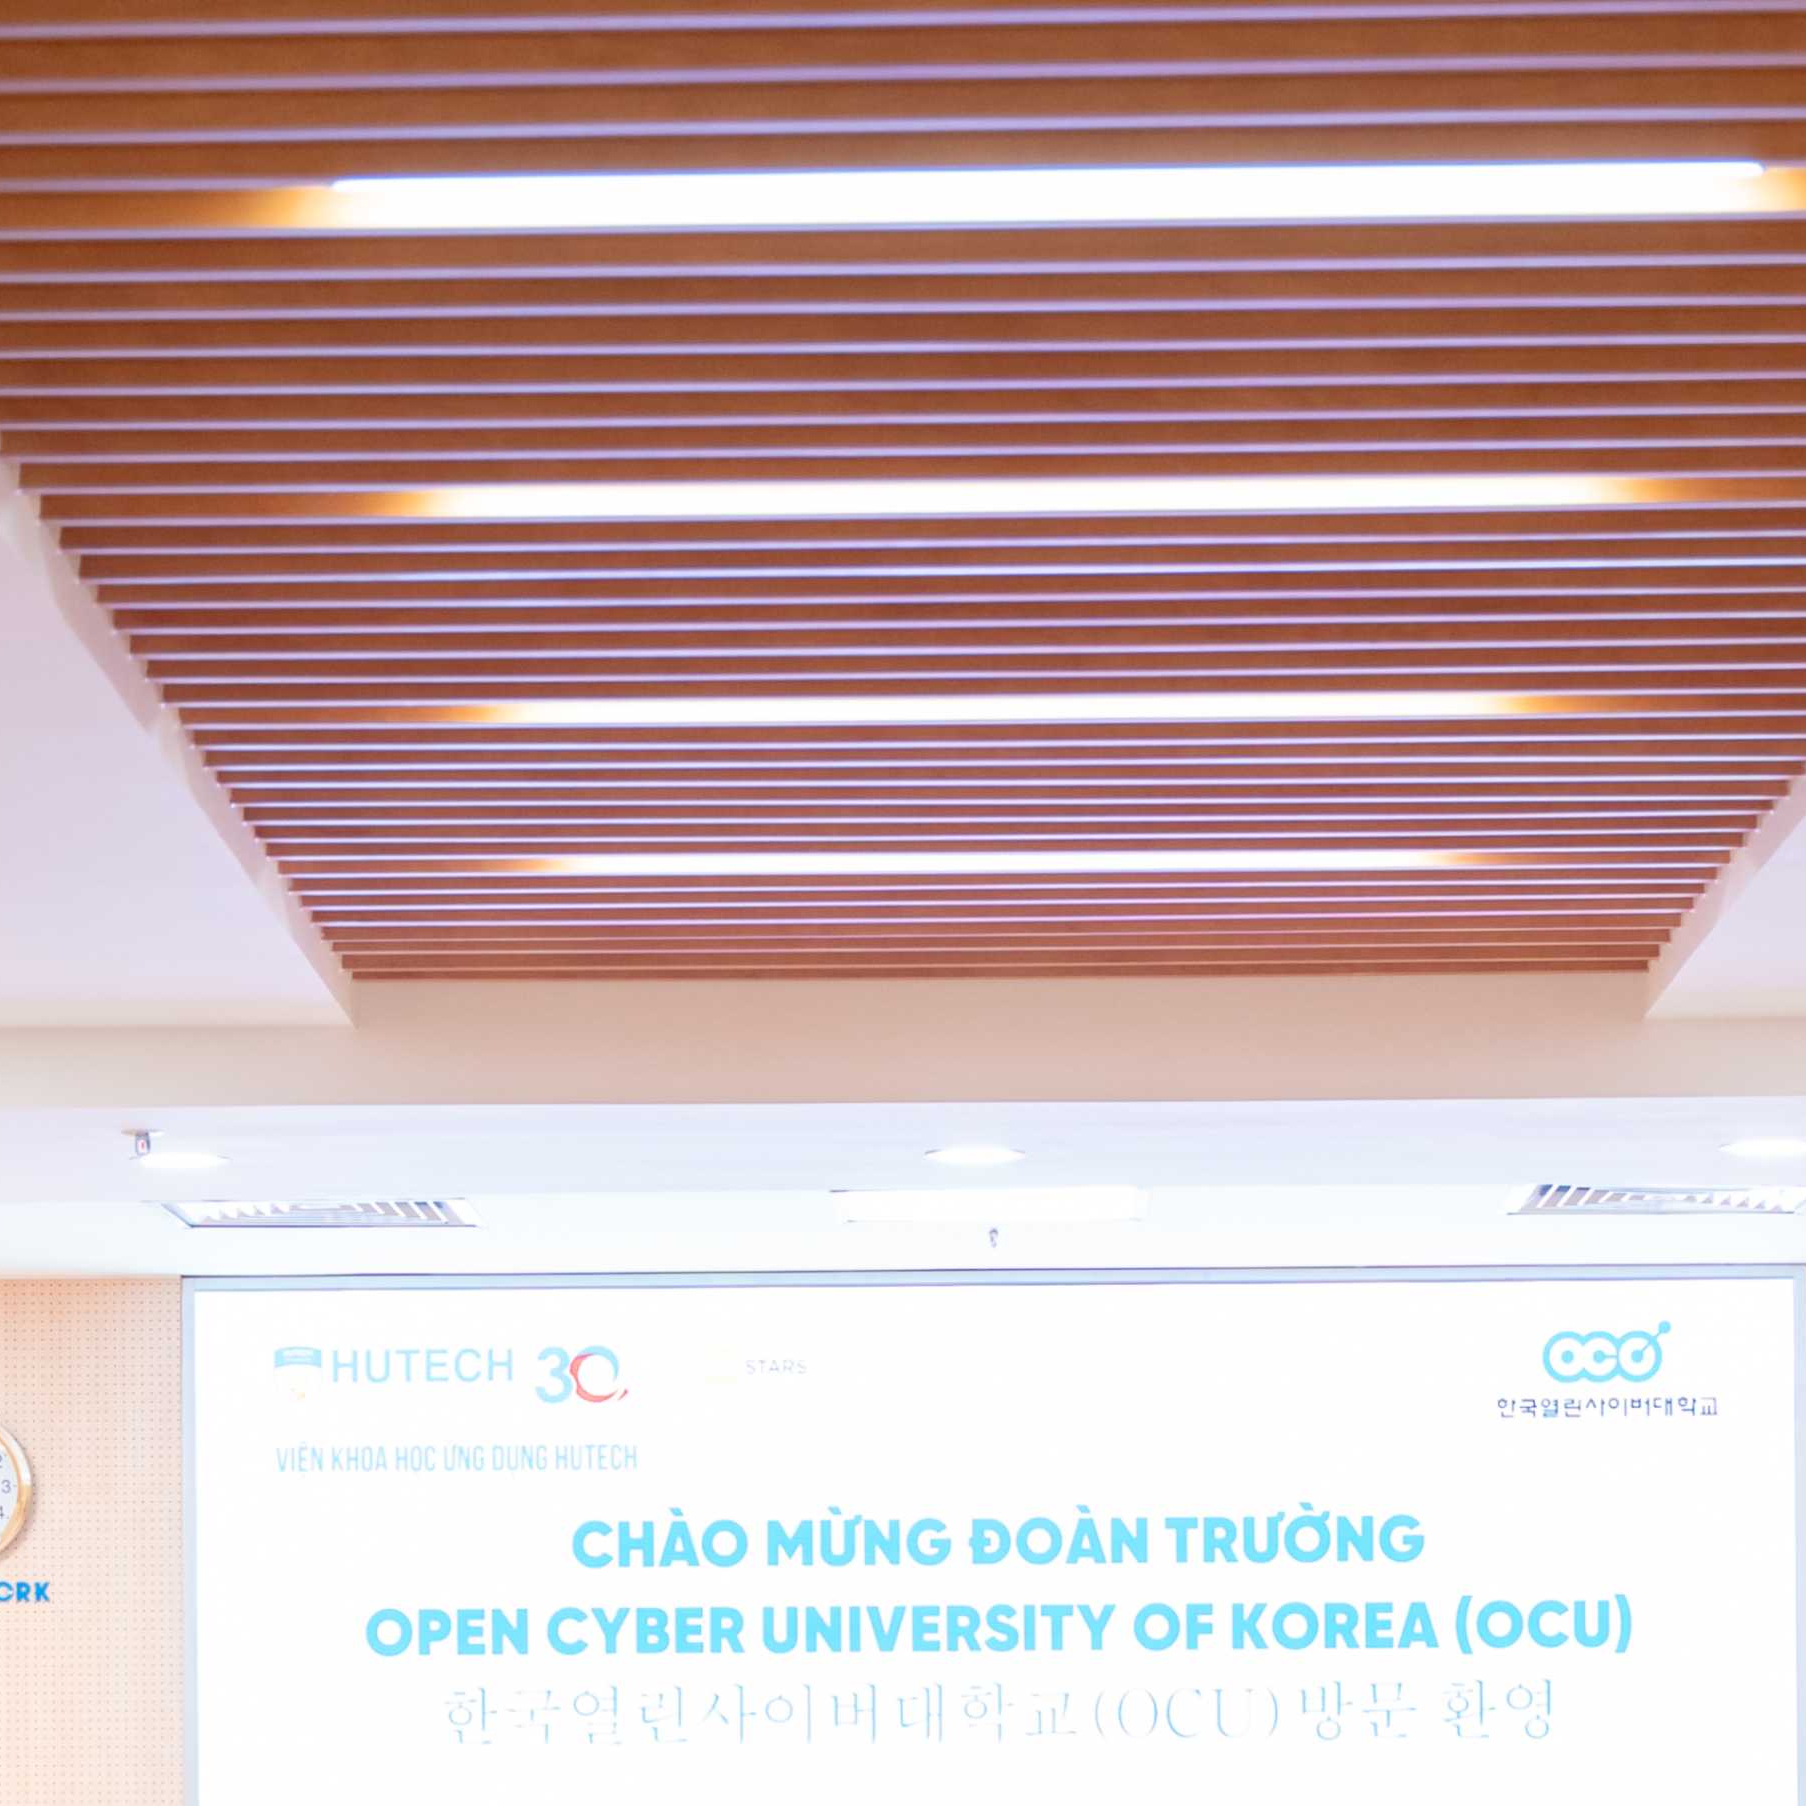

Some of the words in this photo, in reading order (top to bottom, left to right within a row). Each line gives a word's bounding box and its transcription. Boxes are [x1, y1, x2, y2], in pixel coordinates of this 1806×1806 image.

[331, 1346, 514, 1385] HUTECH
[746, 1359, 808, 1376] STARS
[1497, 1395, 1719, 1419] 한국열린사이버대학교
[331, 1445, 388, 1472] KHOA
[554, 1443, 638, 1472] HUTECH
[1, 1480, 11, 1494] 3
[572, 1507, 749, 1569] CHÀO
[766, 1505, 952, 1568] MỪNG
[968, 1504, 1149, 1566] ĐOÀN
[1164, 1501, 1425, 1564] TRƯỜNG
[365, 1608, 529, 1658] OPEN
[547, 1606, 745, 1656] CYBER
[762, 1603, 1117, 1655] UNIVERSITY
[1133, 1602, 1214, 1652] OF
[1231, 1600, 1440, 1651] KOREA
[1455, 1593, 1633, 1657] (OCU)
